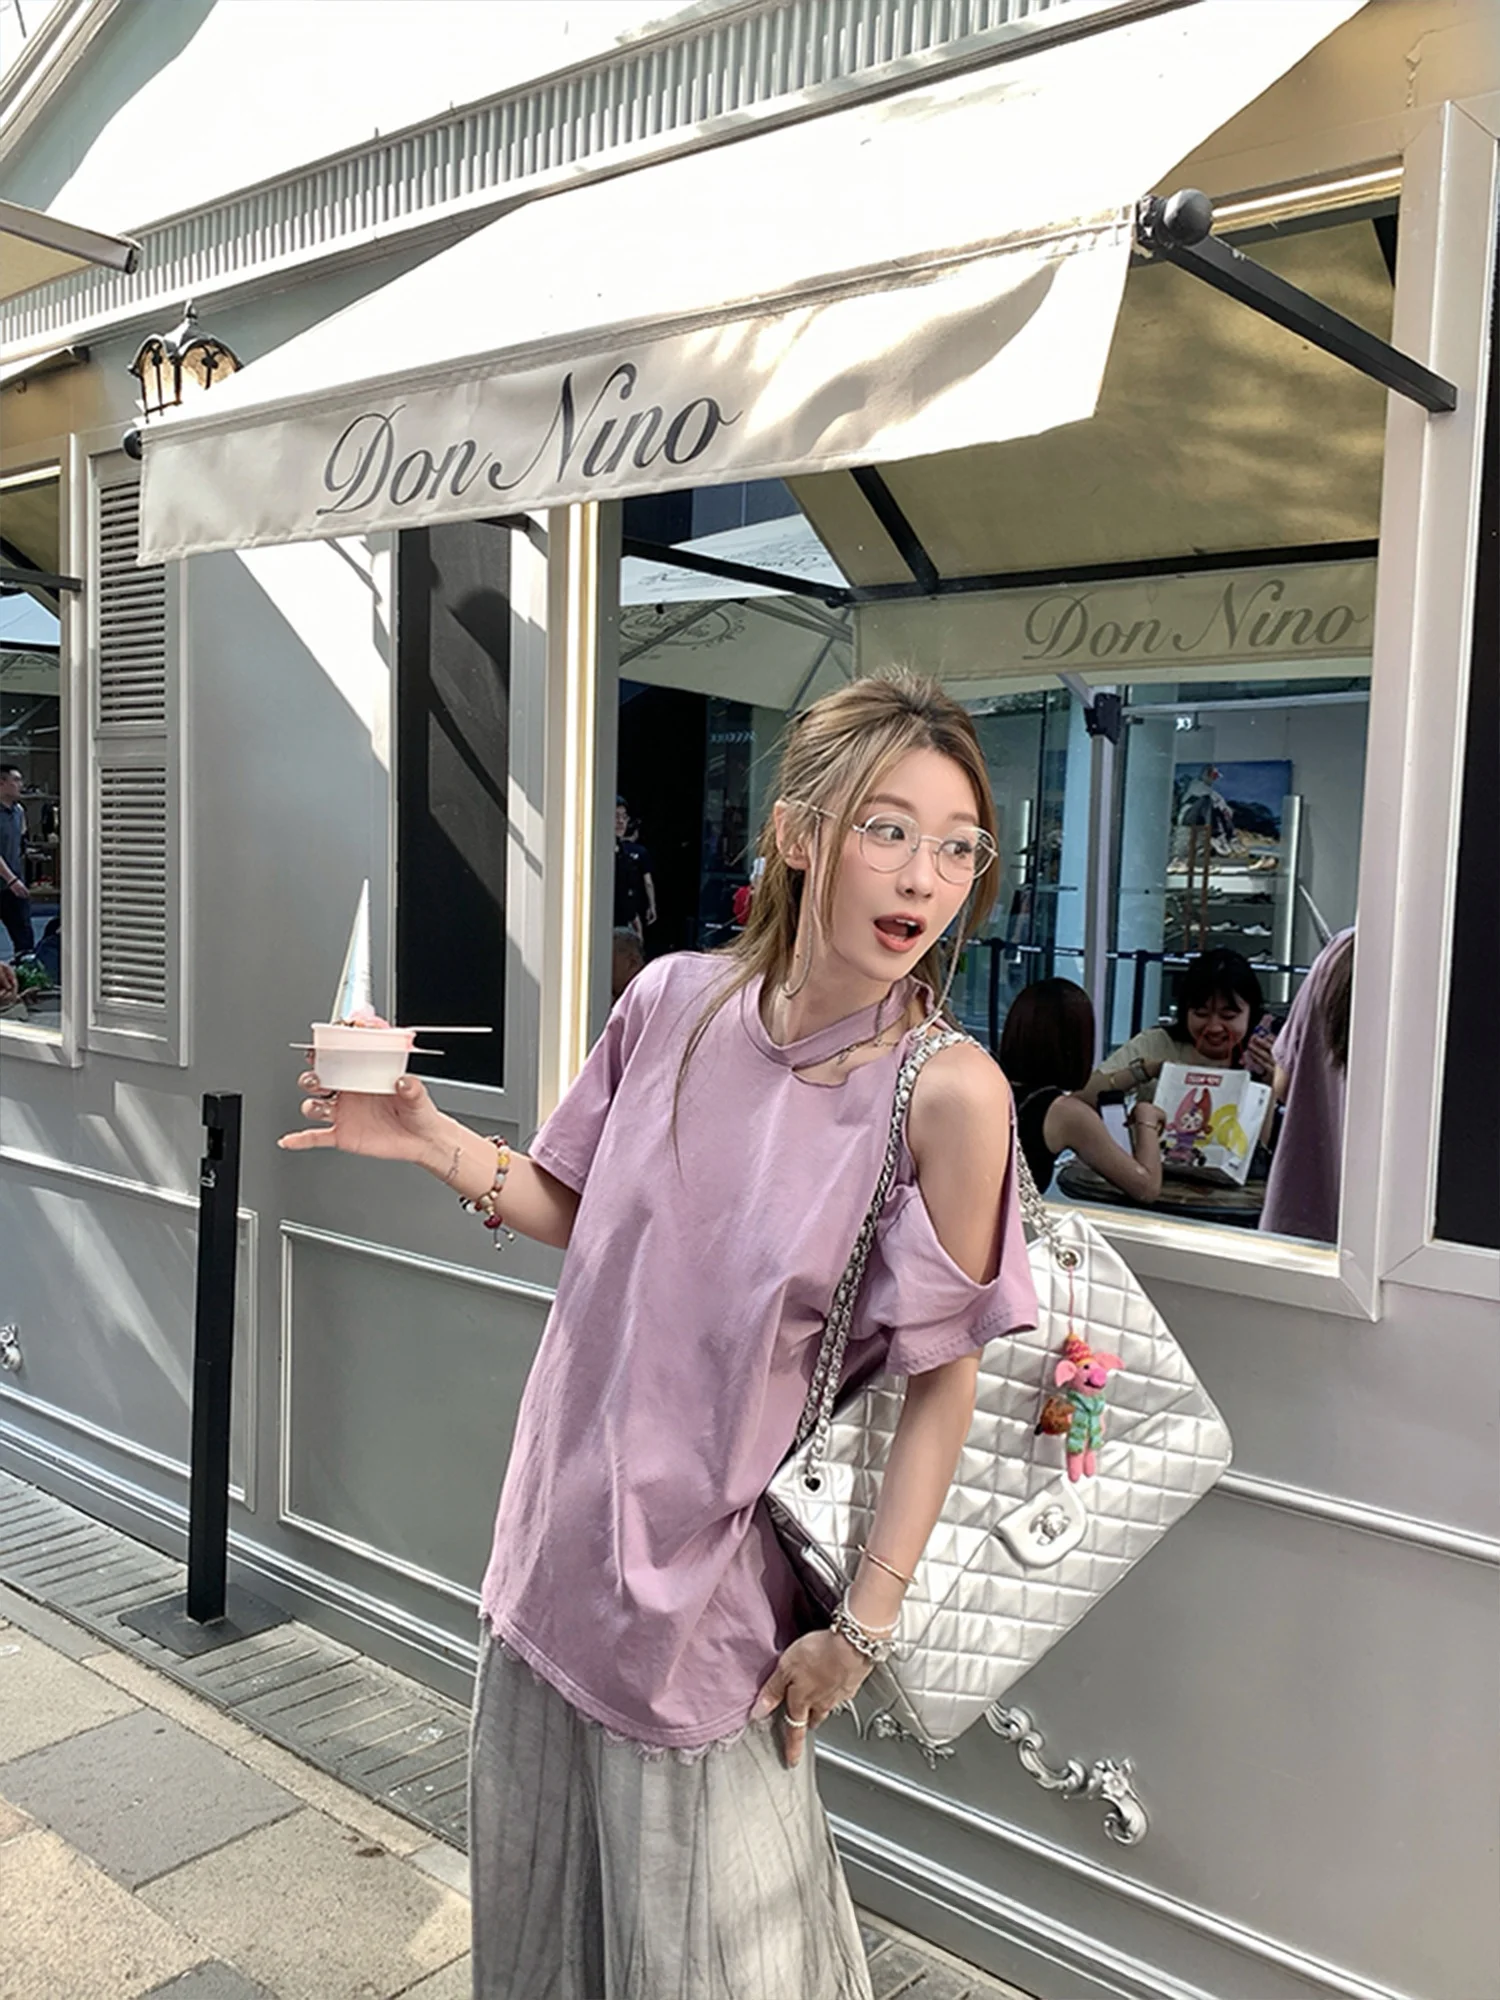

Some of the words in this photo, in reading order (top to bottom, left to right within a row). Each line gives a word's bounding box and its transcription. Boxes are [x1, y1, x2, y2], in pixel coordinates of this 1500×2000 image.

[316, 404, 494, 516] Don
[487, 363, 743, 490] Nino
[1022, 591, 1175, 660] Don
[1172, 579, 1370, 649] Nino
